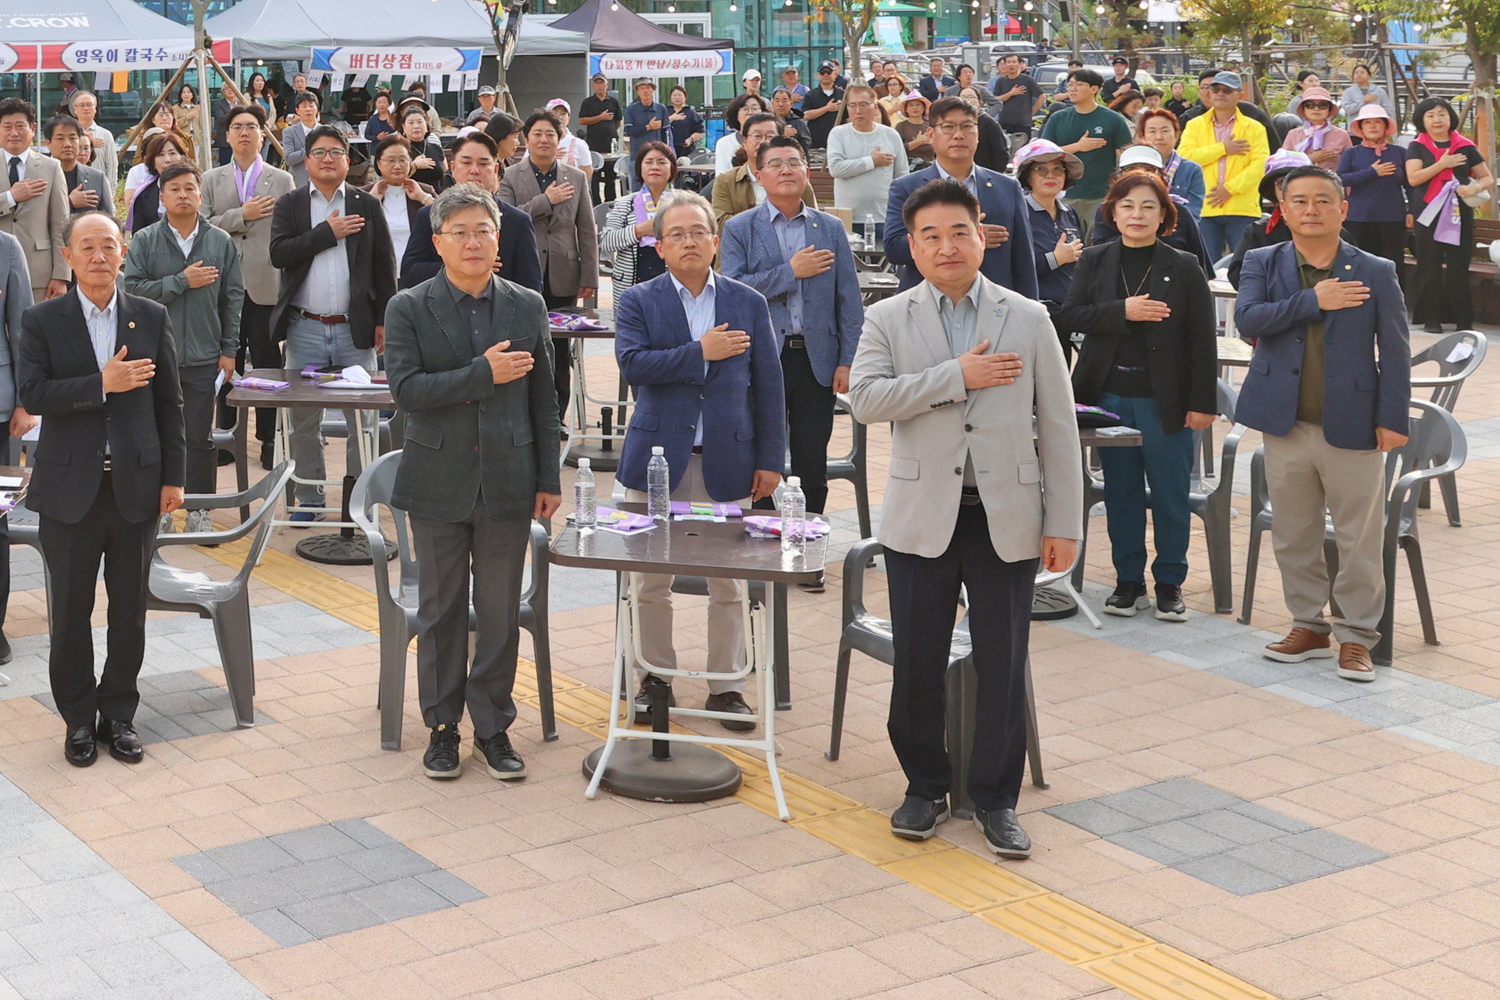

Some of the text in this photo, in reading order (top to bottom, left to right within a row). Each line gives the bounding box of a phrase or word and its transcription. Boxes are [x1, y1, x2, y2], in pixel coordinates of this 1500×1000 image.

[75, 49, 118, 64] 영옥이
[125, 48, 169, 63] 칼국수
[350, 53, 413, 70] 버터상점
[605, 59, 643, 71] 다회용기
